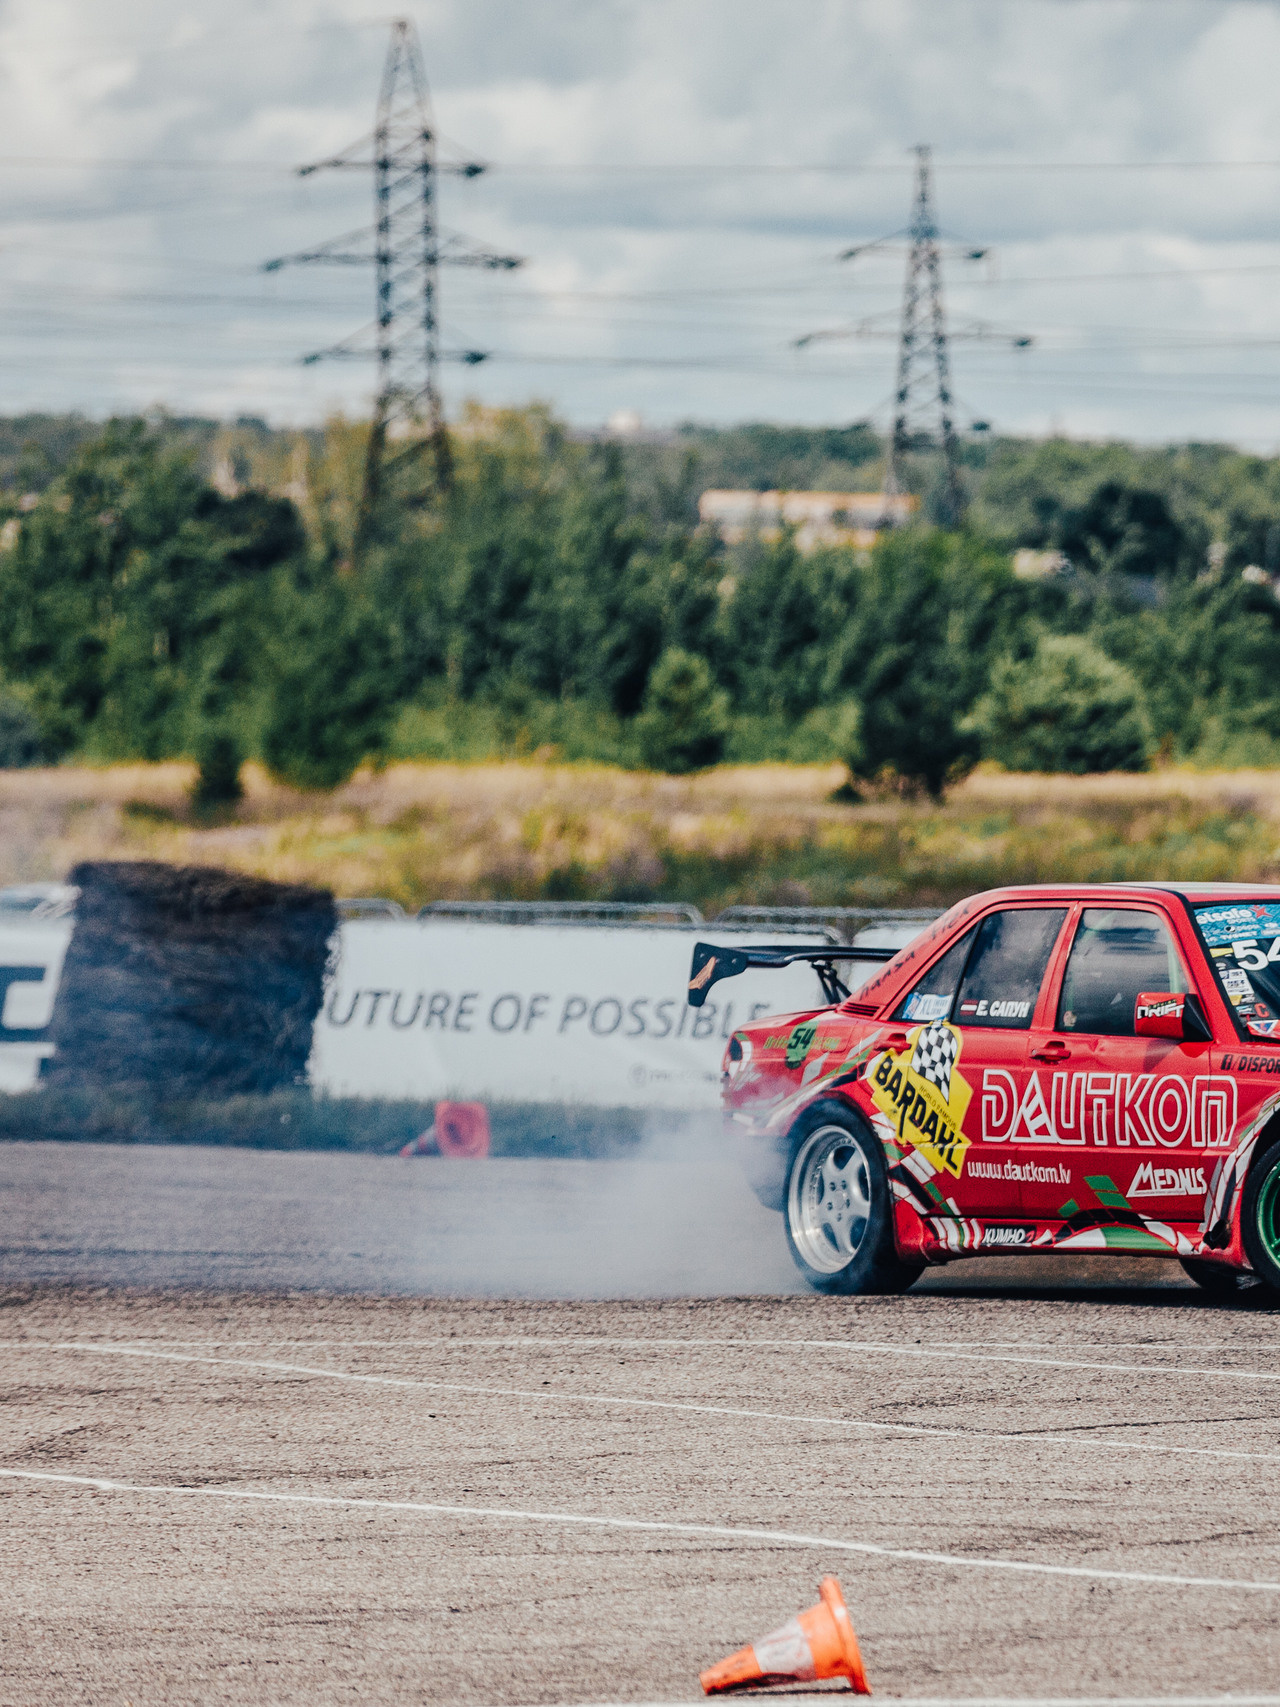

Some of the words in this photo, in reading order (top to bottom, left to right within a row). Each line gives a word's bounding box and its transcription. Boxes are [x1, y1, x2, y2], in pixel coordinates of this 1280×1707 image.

[488, 993, 549, 1033] OF
[787, 1028, 816, 1049] 54
[875, 1055, 963, 1172] BARDAHL
[967, 1160, 1071, 1184] www.dautkom.lv
[981, 1228, 1026, 1244] KUMHO
